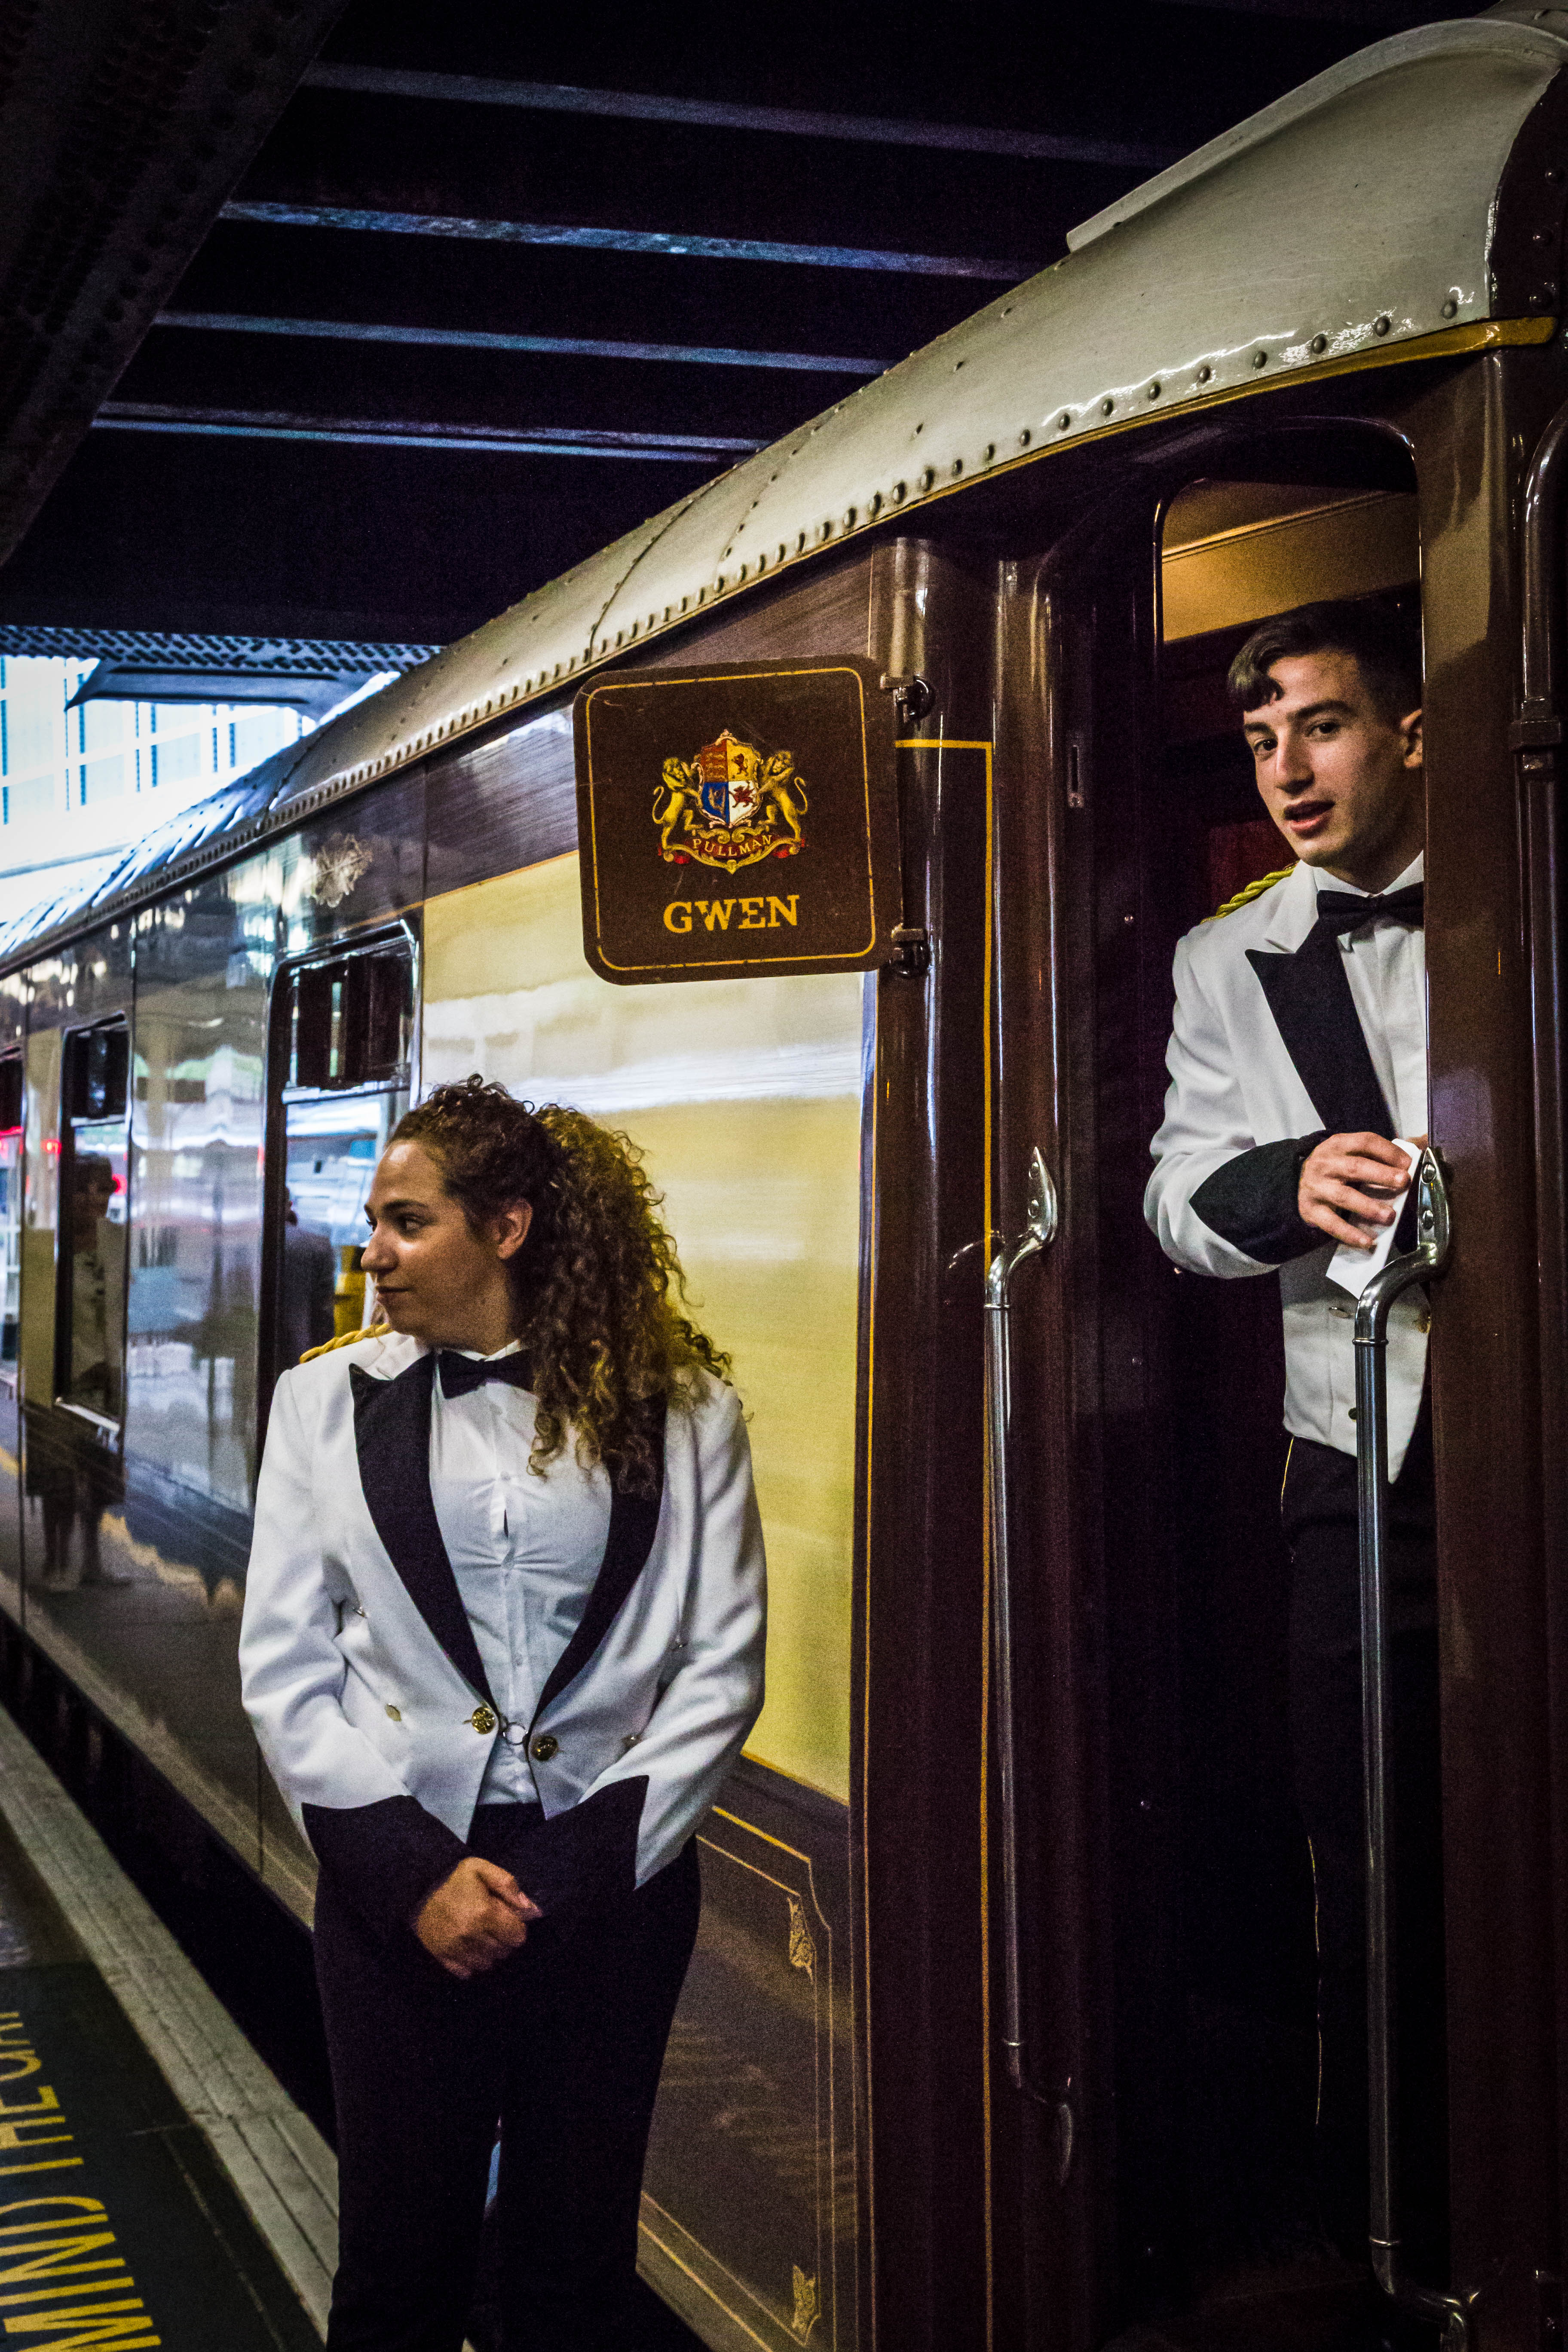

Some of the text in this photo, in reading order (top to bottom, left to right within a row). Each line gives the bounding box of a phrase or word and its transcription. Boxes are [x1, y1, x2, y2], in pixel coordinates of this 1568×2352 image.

[693, 835, 772, 856] PULLMAN
[664, 895, 799, 933] GWEN
[0, 2196, 162, 2352] MIND
